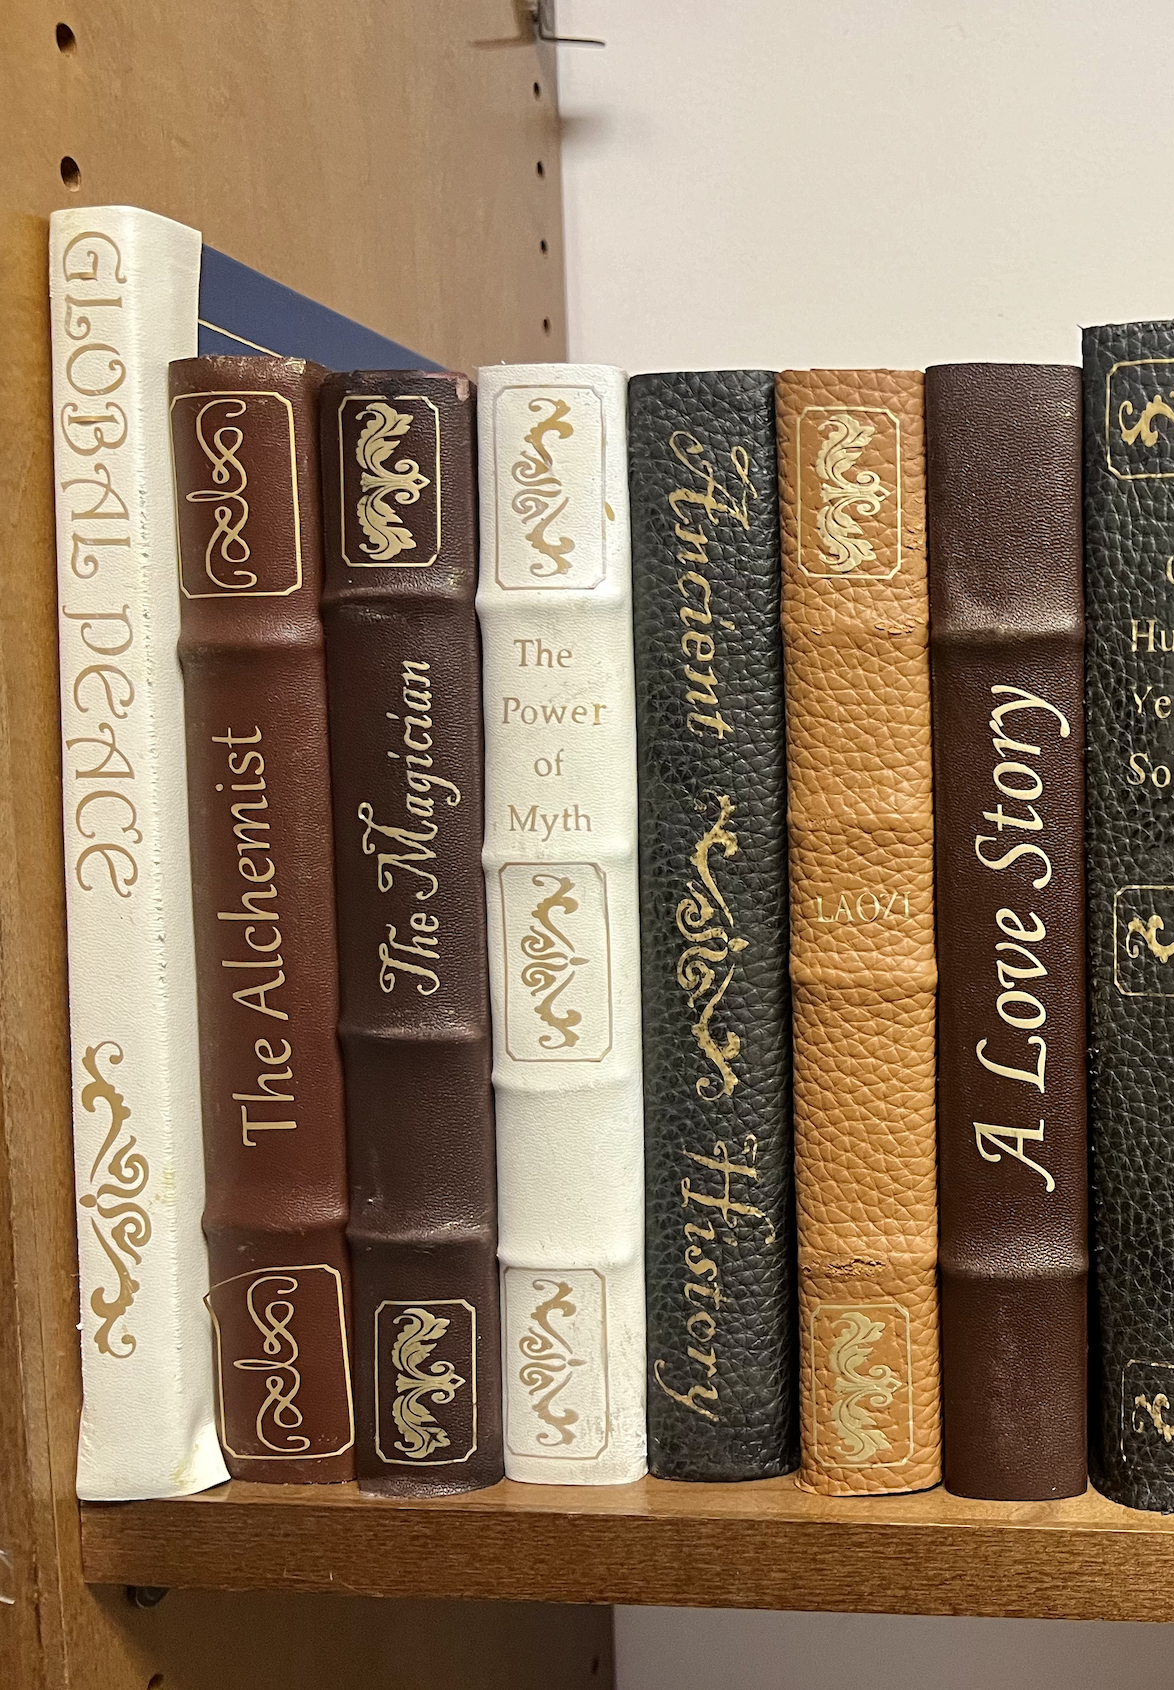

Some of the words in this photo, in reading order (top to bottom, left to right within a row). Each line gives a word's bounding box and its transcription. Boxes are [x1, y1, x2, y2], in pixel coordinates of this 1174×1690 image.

[62, 230, 131, 580] GLOBAL
[668, 430, 758, 741] Ancient
[513, 639, 573, 668] The
[502, 697, 607, 726] Power
[534, 749, 564, 777] of
[357, 658, 461, 901] Magician
[508, 804, 592, 842] Myth
[974, 684, 1071, 889] Story
[211, 725, 288, 1020] Alchemist
[816, 888, 911, 923] LAOZI
[380, 910, 441, 996] The
[975, 908, 1048, 1094] Love
[233, 1038, 298, 1147] The
[972, 1118, 1056, 1193] A
[654, 1134, 775, 1422] History
